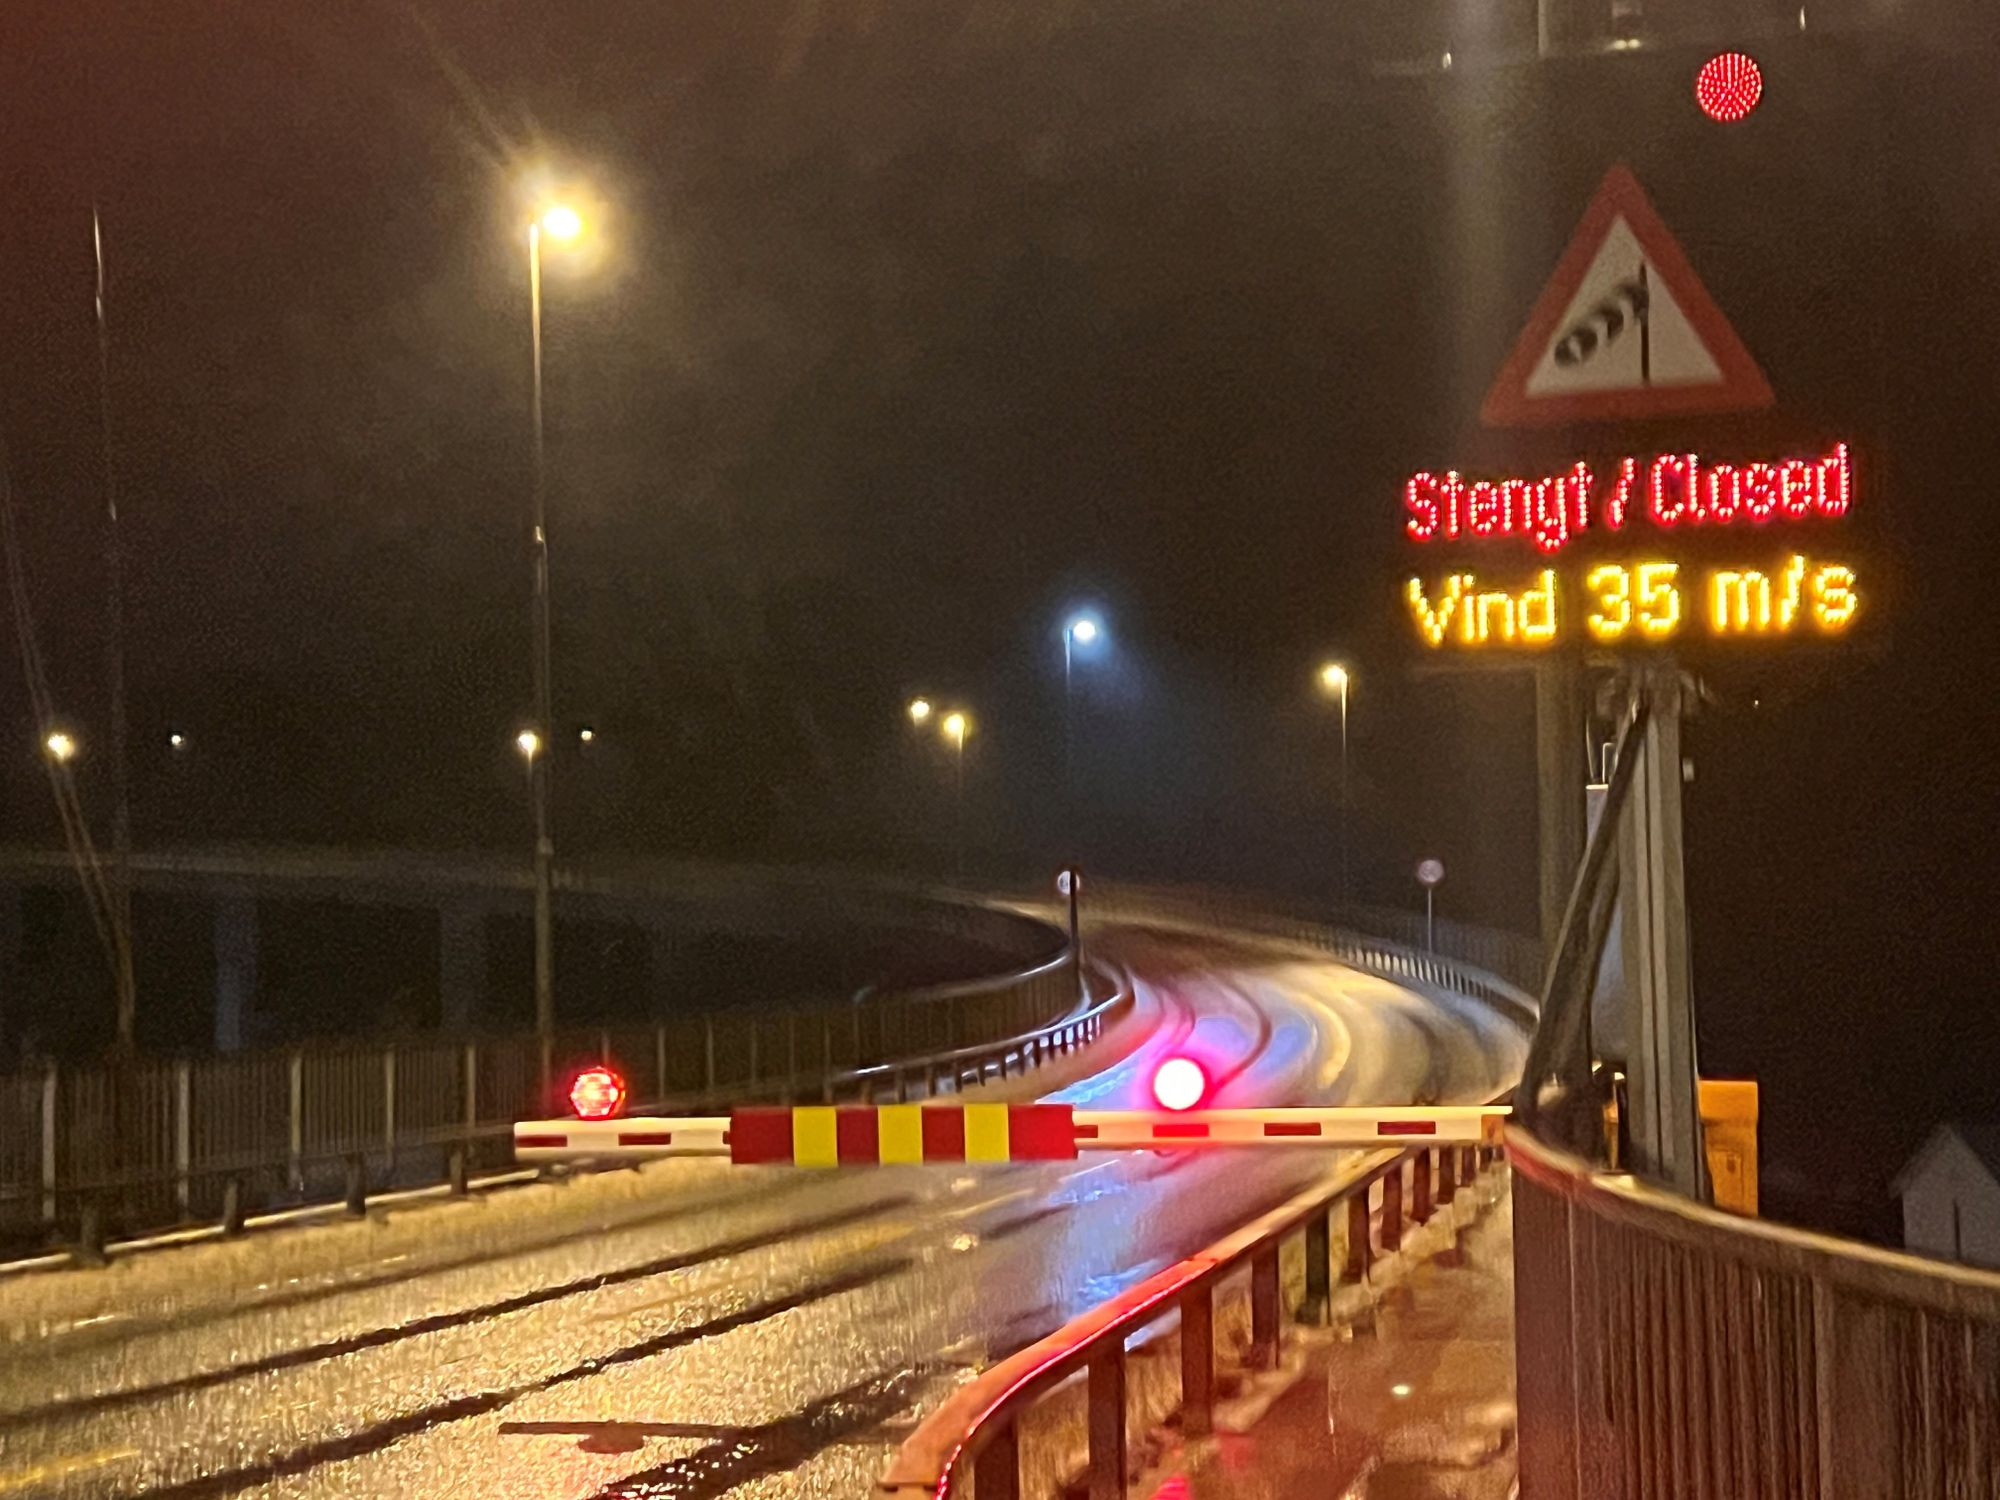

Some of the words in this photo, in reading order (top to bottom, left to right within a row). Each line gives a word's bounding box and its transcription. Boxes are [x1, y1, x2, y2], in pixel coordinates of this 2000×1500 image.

[1407, 462, 1593, 551] Stengt
[1608, 457, 1635, 528] /
[1652, 442, 1851, 522] Closed
[1409, 569, 1557, 645] Vind
[1588, 561, 1681, 637] 35
[1714, 555, 1857, 632] m/s
